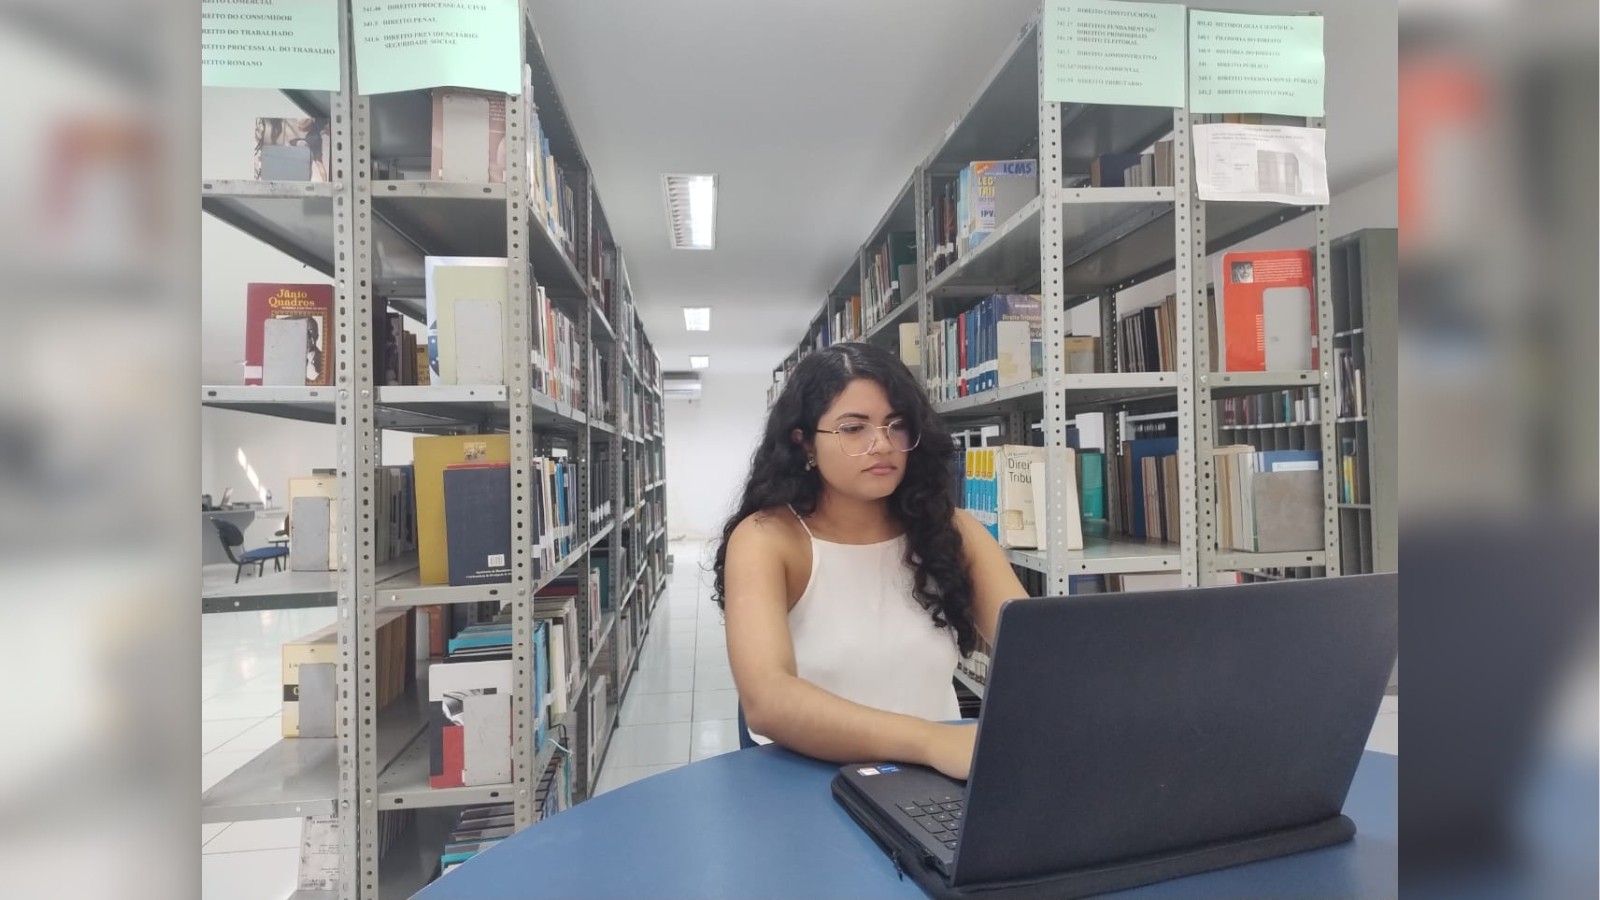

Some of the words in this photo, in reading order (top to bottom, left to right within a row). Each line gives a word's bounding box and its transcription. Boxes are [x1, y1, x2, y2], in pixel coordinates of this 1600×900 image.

[383, 18, 413, 26] DIREITO
[241, 29, 294, 37] TRABALHADO
[384, 40, 428, 48] SEGURIDADE
[227, 44, 276, 52] PROCESSUAL
[293, 47, 336, 55] TRABALHO
[1003, 162, 1032, 175] ICMS
[978, 175, 996, 187] LEG
[980, 209, 996, 218] IPV
[268, 296, 315, 308] Quadros
